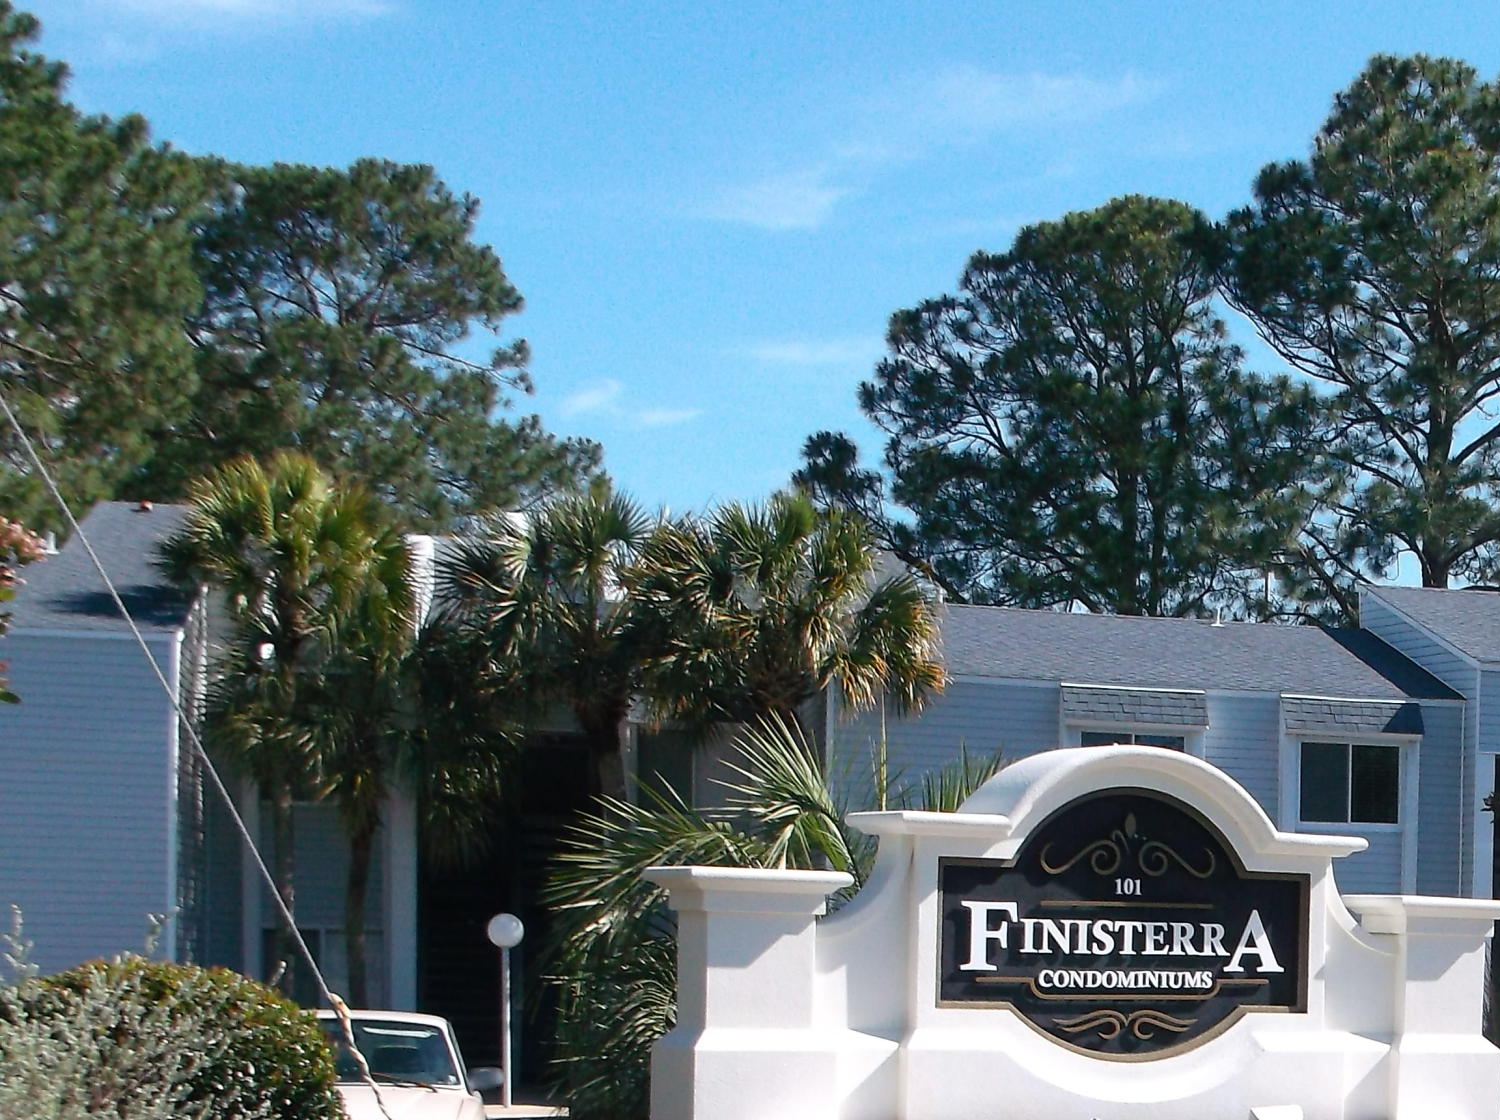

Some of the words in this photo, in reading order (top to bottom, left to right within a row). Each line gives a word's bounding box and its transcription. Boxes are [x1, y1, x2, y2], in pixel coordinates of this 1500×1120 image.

[1114, 878, 1142, 896] 101
[959, 901, 1284, 973] FINISTERRA
[1038, 970, 1213, 989] CONDOMINIUMS
